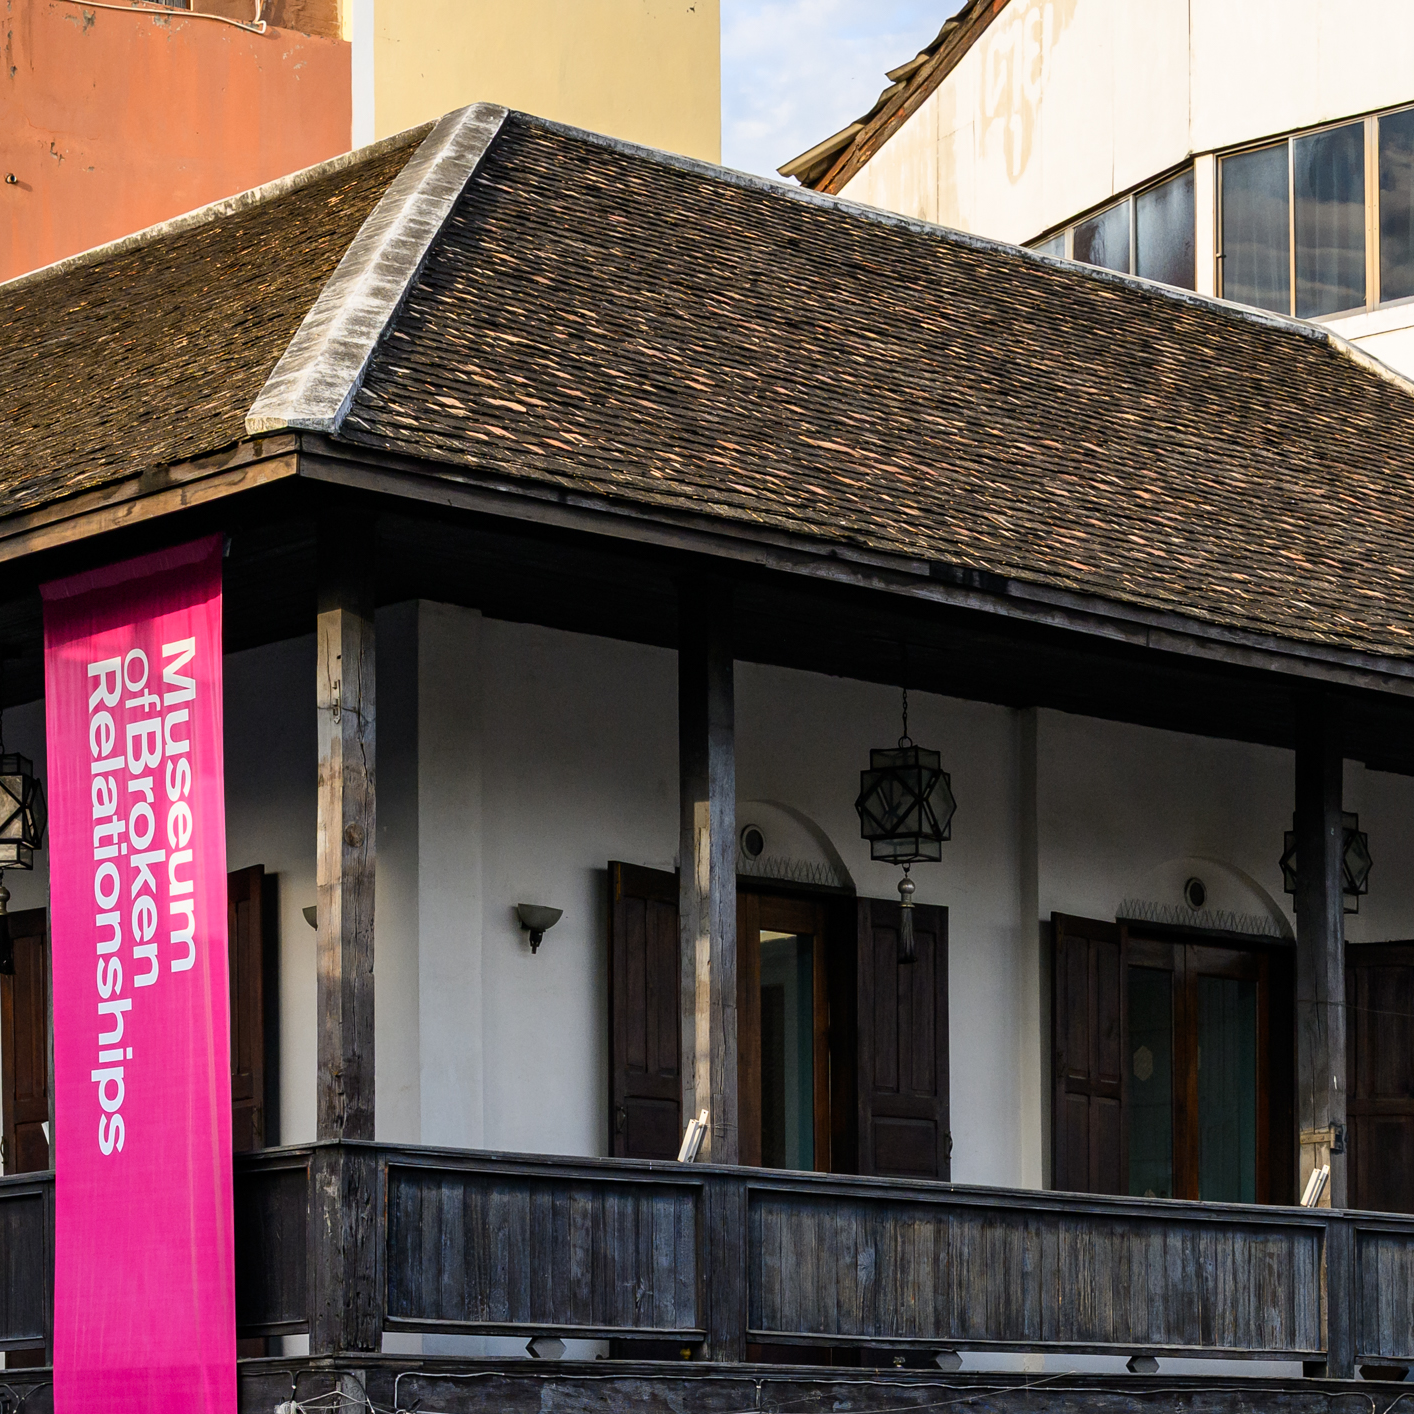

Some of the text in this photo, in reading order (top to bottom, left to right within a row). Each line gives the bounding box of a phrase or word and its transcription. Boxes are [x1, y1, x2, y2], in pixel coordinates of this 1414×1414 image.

[87, 656, 133, 1156] Relationships
[123, 648, 166, 988] of Broken
[161, 636, 196, 973] Museum
